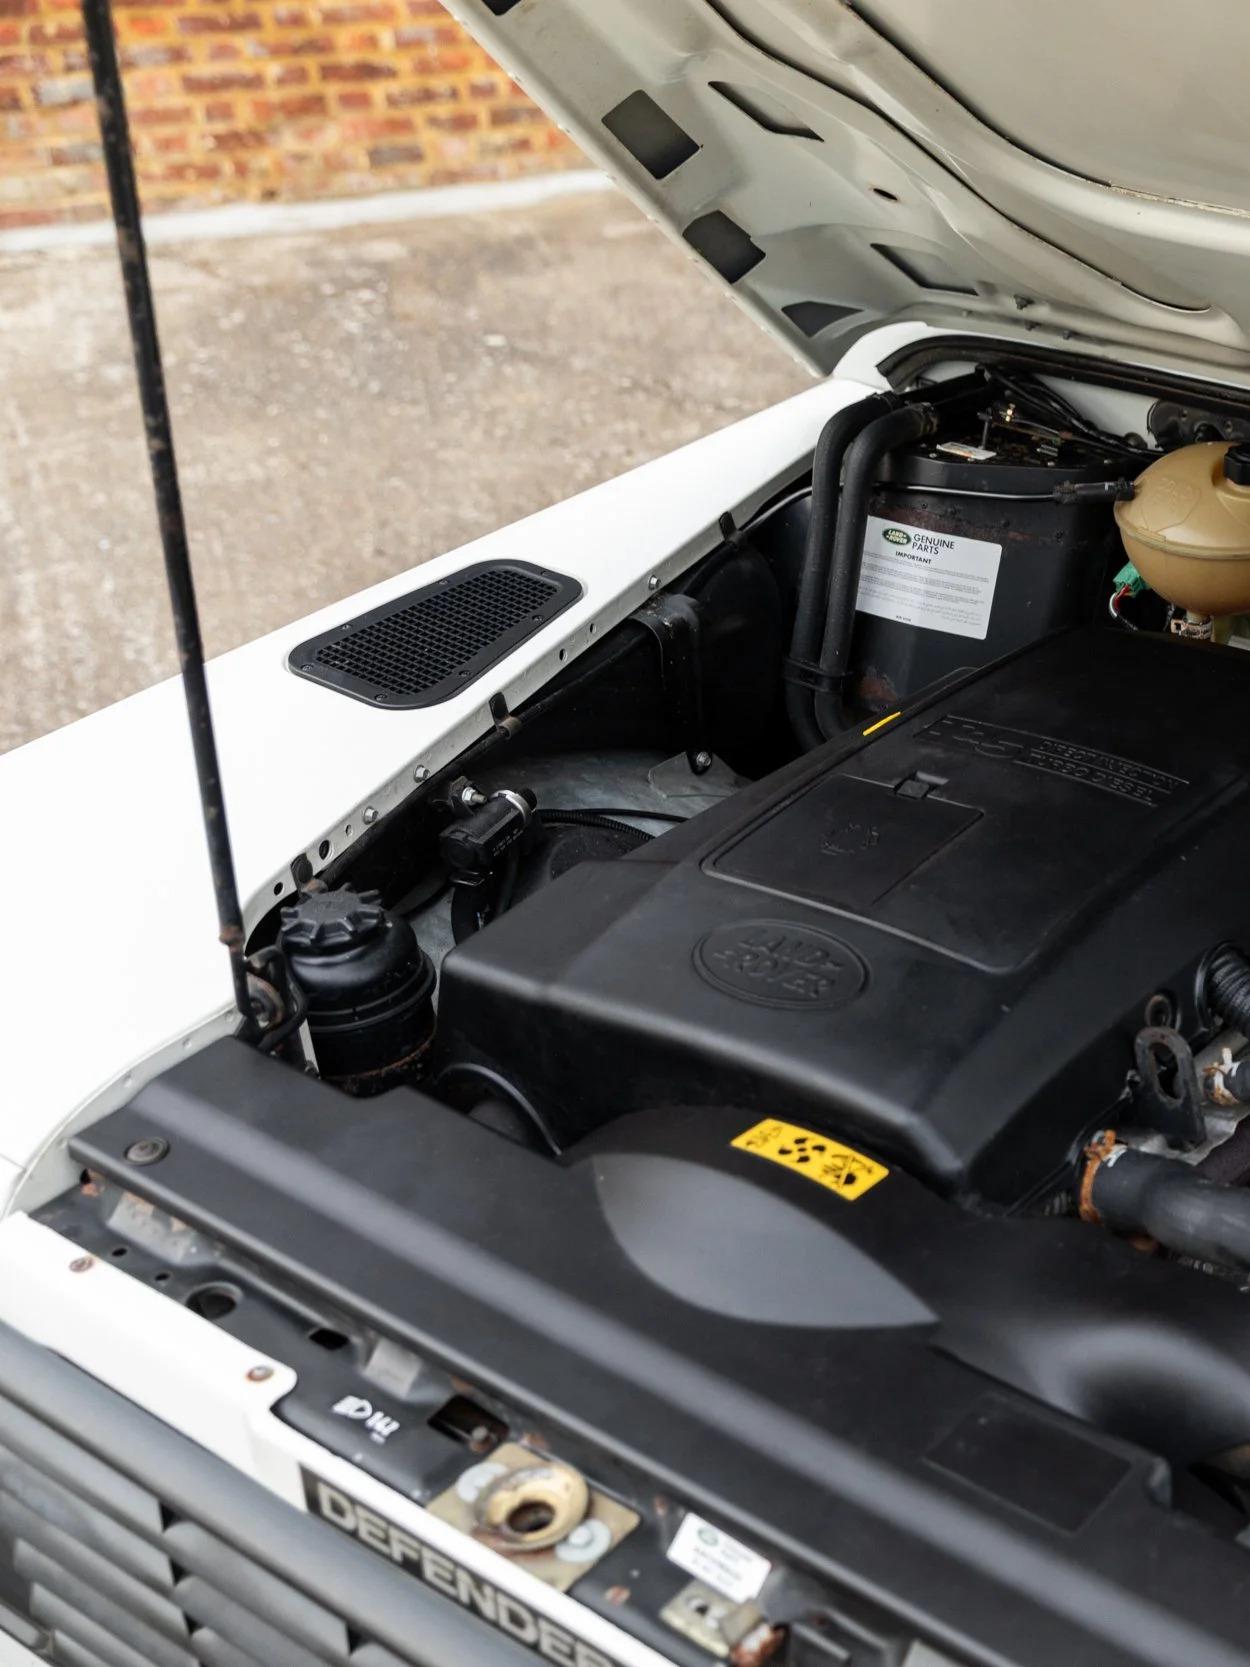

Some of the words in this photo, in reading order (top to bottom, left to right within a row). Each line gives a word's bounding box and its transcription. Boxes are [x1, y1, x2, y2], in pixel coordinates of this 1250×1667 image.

[912, 541, 939, 555] PARTS
[913, 533, 956, 550] GENUINE
[895, 550, 932, 564] IMPORTANT
[317, 1480, 614, 1667] DEFENDER
